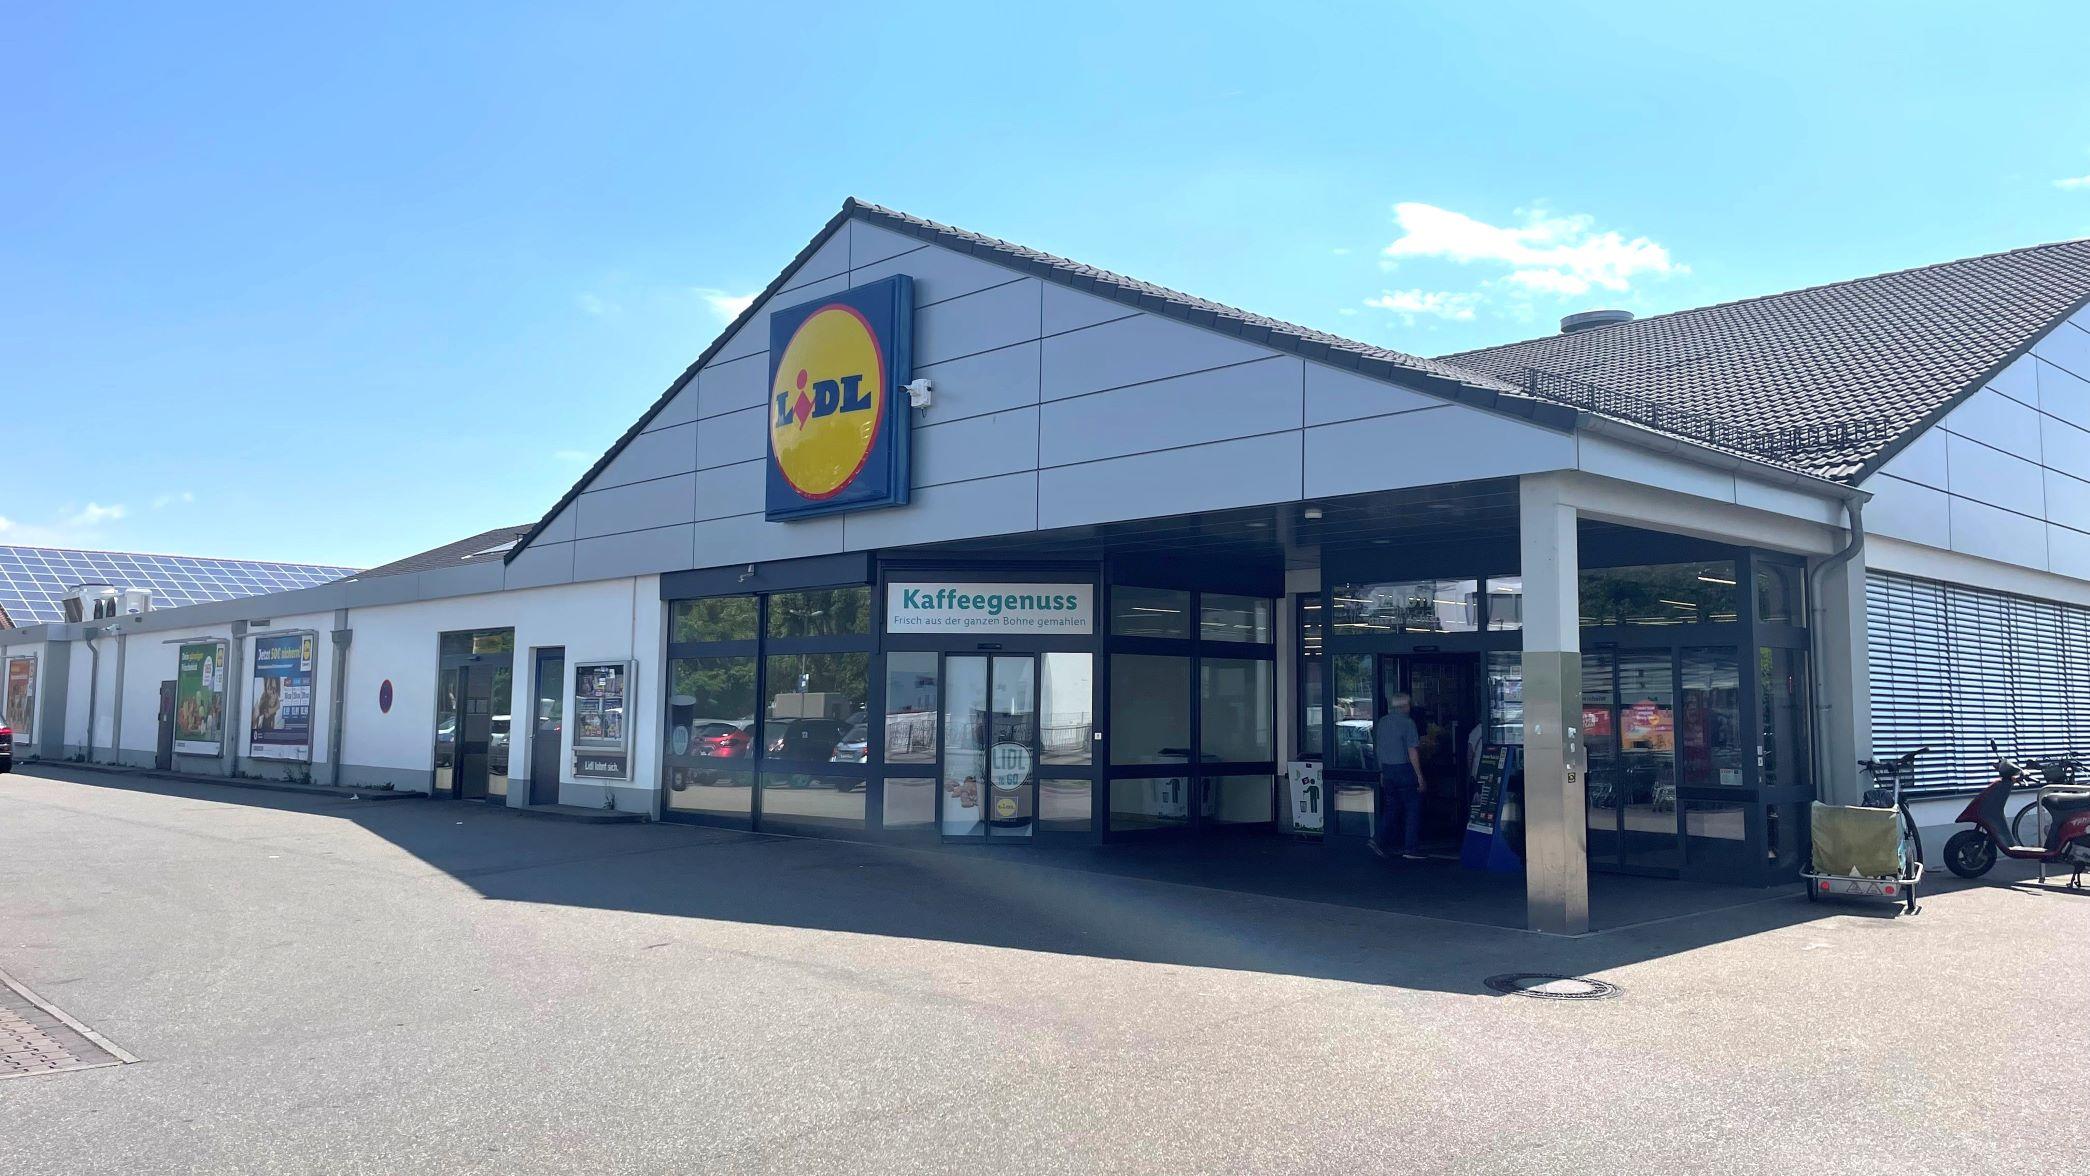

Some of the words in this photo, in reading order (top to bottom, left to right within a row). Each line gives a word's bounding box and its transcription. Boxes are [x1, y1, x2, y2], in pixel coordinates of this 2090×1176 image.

[903, 588, 1078, 616] Kaffeegenuss
[894, 615, 922, 625] Frisch
[925, 617, 942, 625] aus
[945, 616, 961, 625] der
[963, 617, 1000, 628] ganzen
[1003, 616, 1034, 626] Bohne
[1037, 616, 1086, 628] gemahlen
[992, 748, 1026, 770] LIDL
